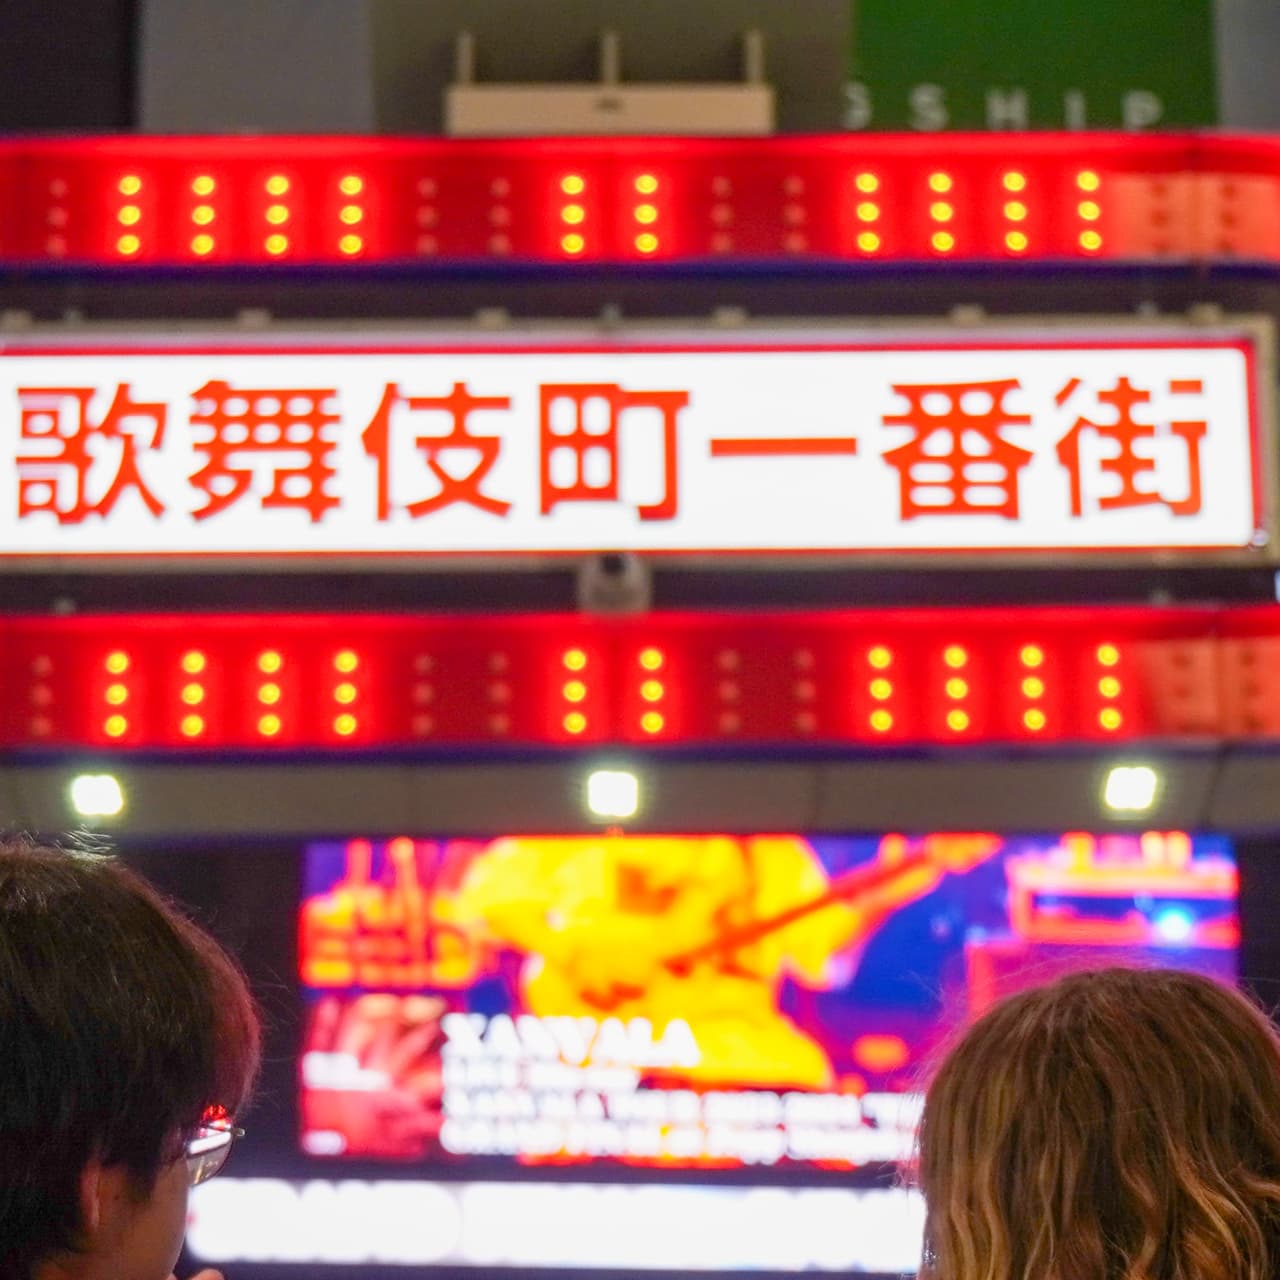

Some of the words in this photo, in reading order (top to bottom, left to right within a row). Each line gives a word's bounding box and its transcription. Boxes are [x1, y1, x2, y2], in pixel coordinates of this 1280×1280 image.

[15, 379, 1207, 522] 歌舞伎町一番街
